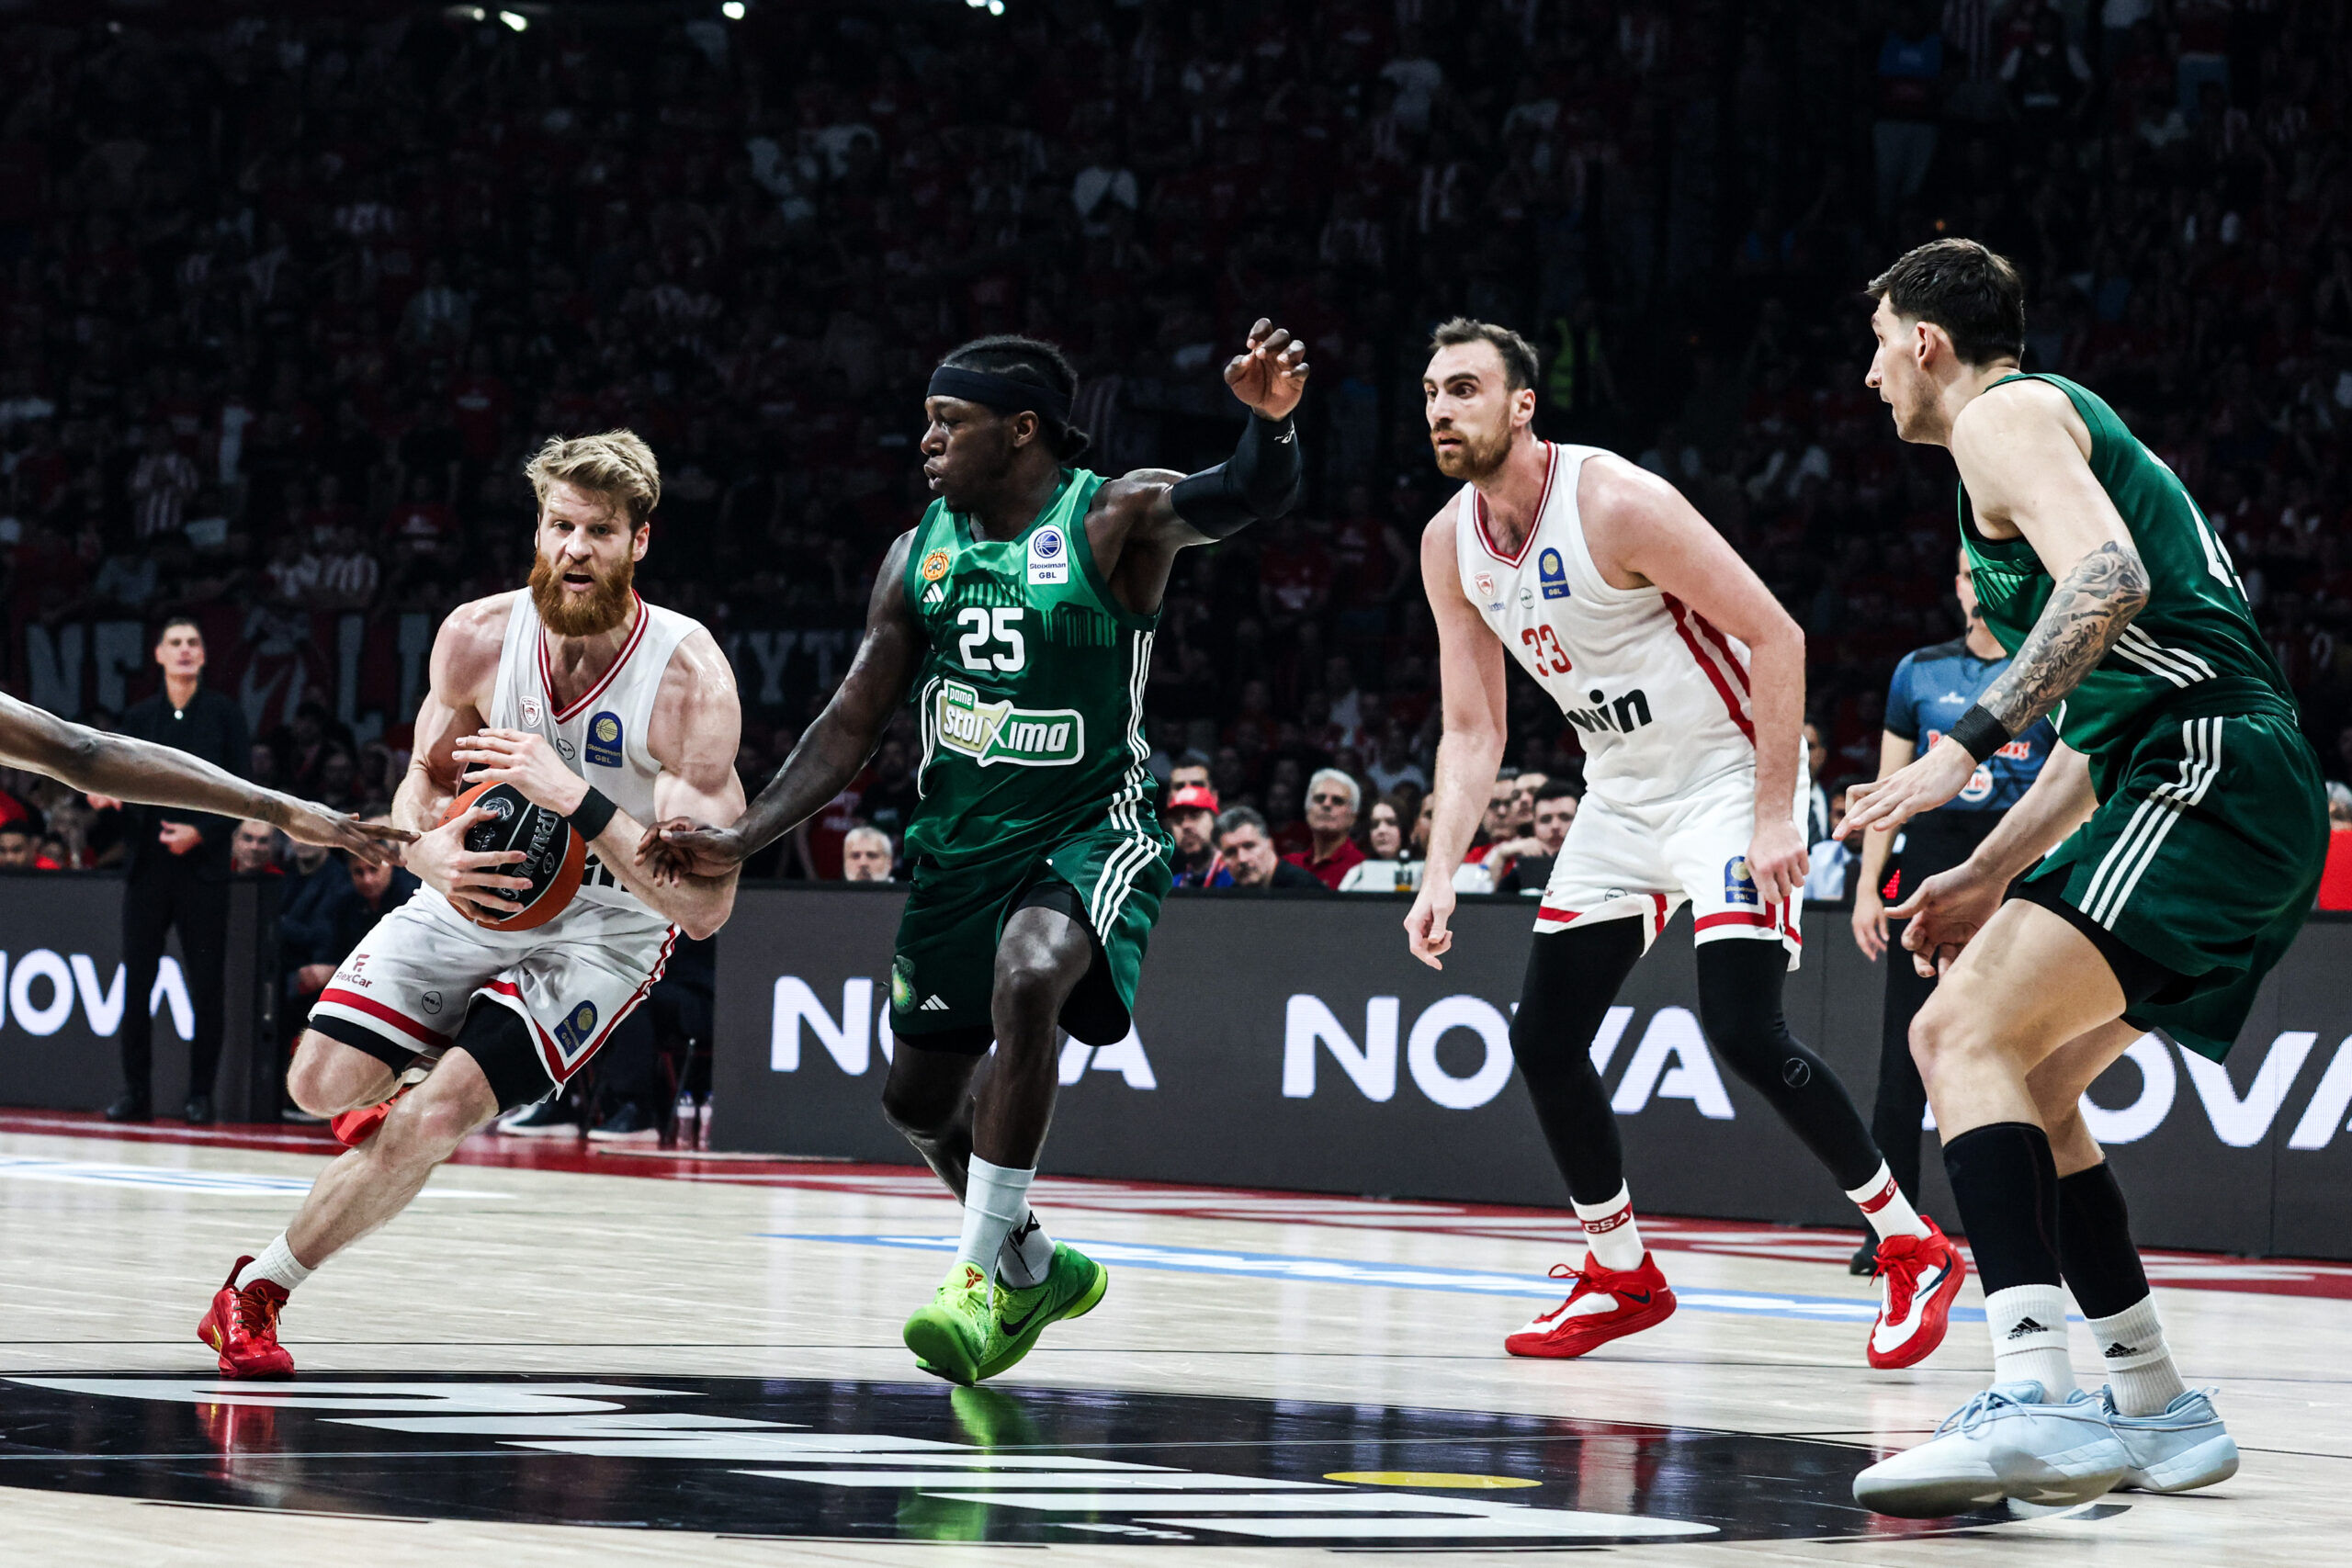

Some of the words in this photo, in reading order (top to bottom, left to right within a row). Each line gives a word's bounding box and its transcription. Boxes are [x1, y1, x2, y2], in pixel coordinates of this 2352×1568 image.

[957, 607, 1025, 671] 25
[1521, 624, 1572, 677] 33
[0, 948, 195, 1041] OVA
[770, 976, 1158, 1090] NA
[1922, 1028, 2352, 1150] OV
[1584, 1212, 1629, 1233] GSA
